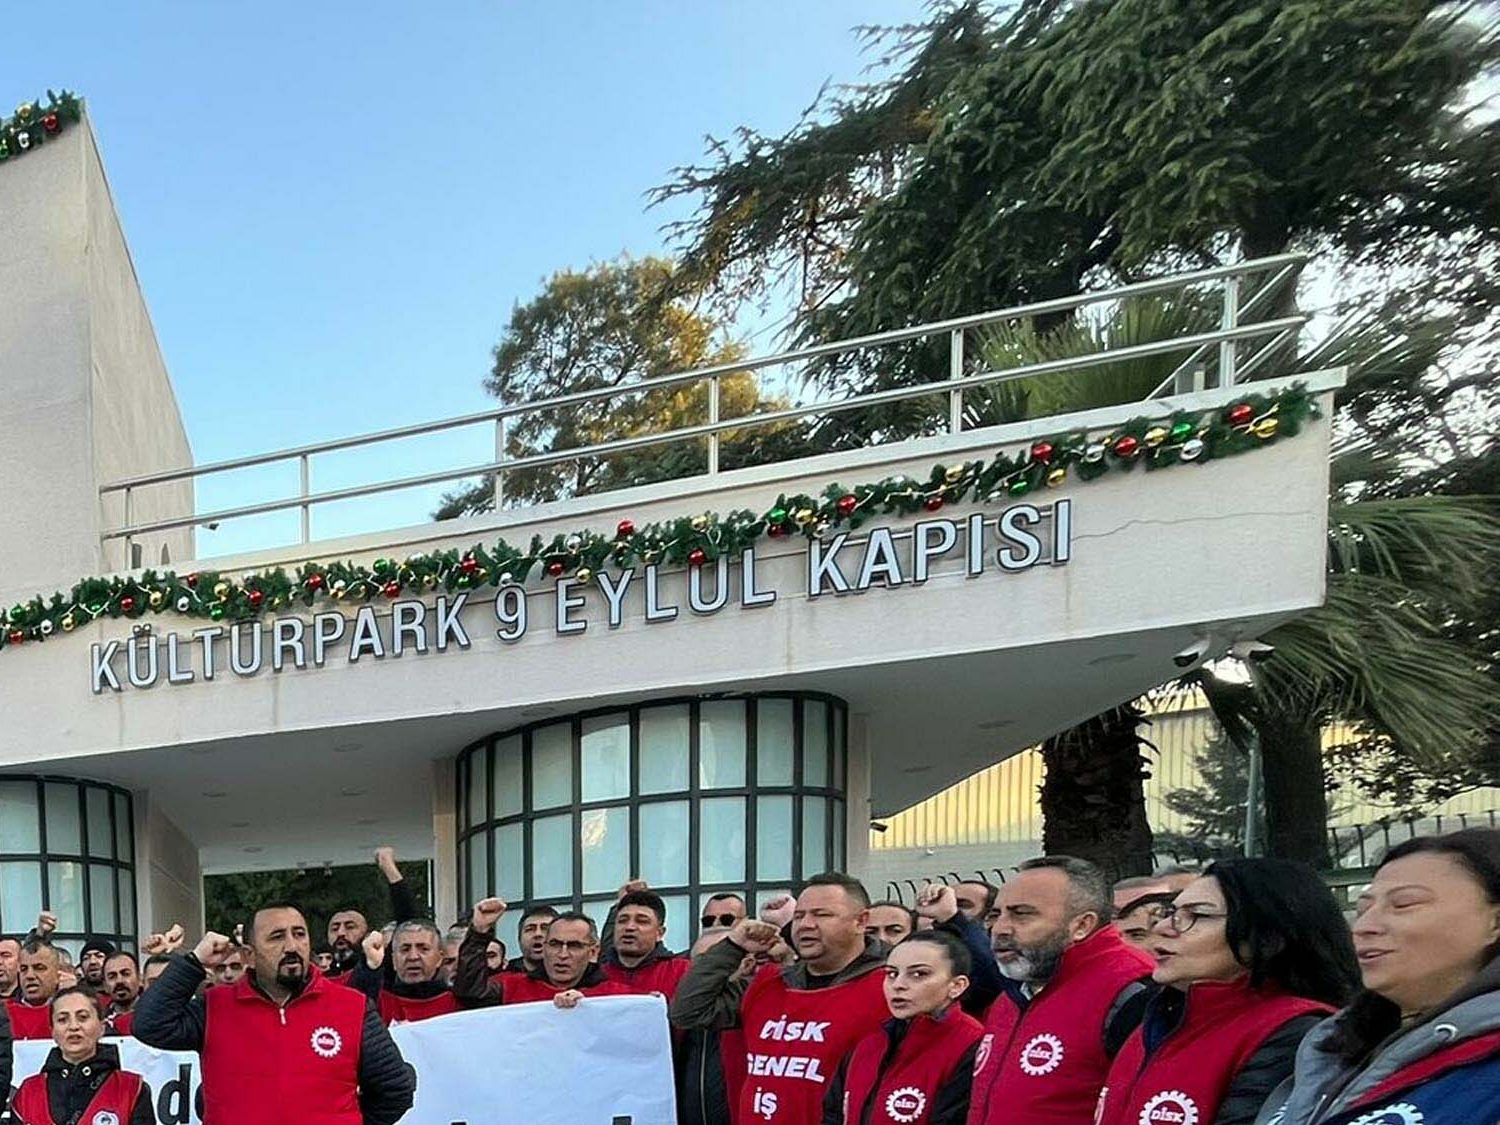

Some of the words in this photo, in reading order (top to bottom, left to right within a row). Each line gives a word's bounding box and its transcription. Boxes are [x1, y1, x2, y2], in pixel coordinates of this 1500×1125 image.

[495, 582, 527, 642] 9
[808, 499, 1072, 602] KAPISI
[754, 1086, 777, 1120] İŞ
[1151, 1106, 1184, 1123] DİSK
